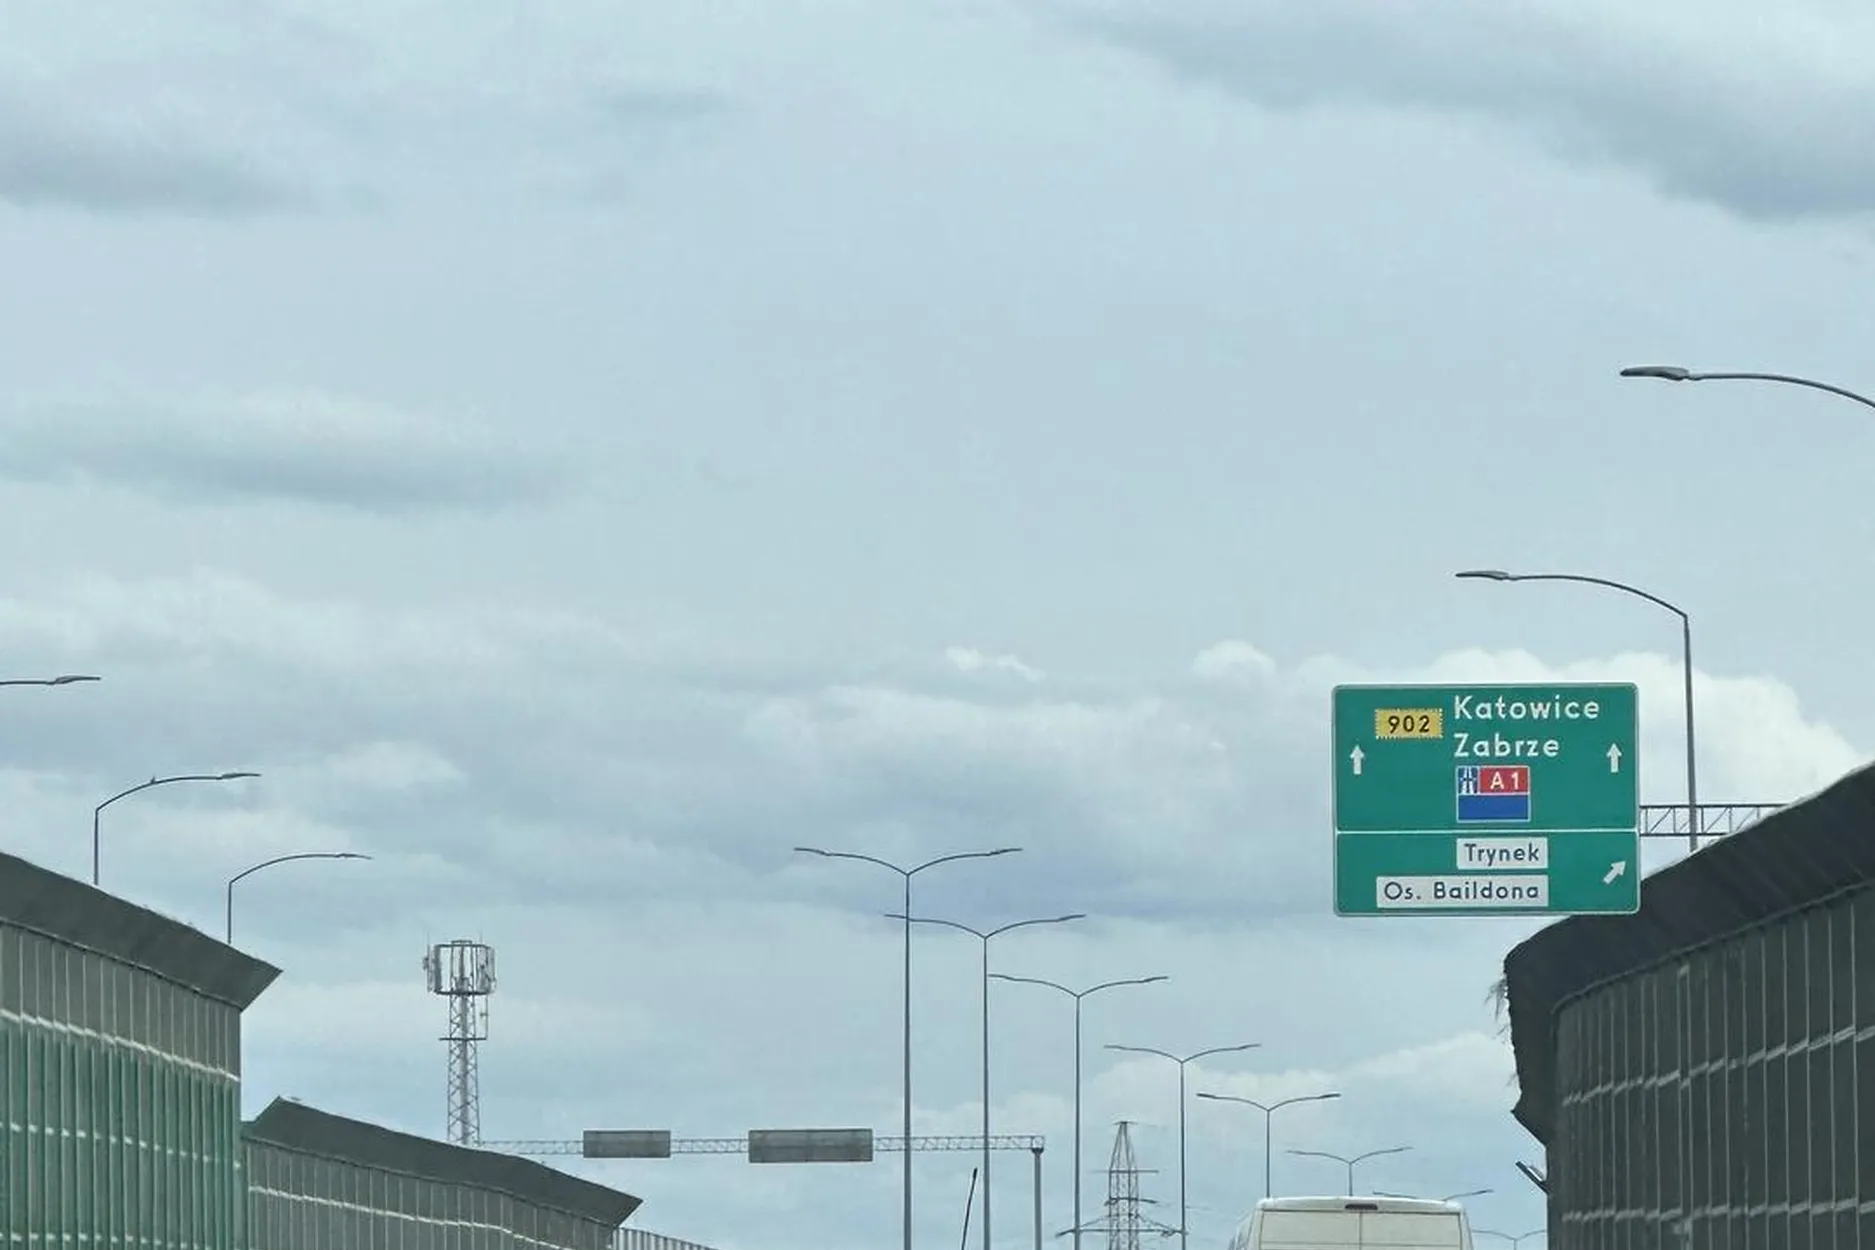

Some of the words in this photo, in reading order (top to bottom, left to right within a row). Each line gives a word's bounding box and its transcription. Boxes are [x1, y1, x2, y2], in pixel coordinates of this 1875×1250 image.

[1454, 695, 1600, 720] Katowice
[1388, 715, 1431, 734] 902
[1454, 733, 1560, 757] Zabrze
[1490, 772, 1519, 790] A1
[1464, 843, 1540, 867] Trynek
[1384, 881, 1421, 900] Os.
[1434, 880, 1539, 900] Baildona
